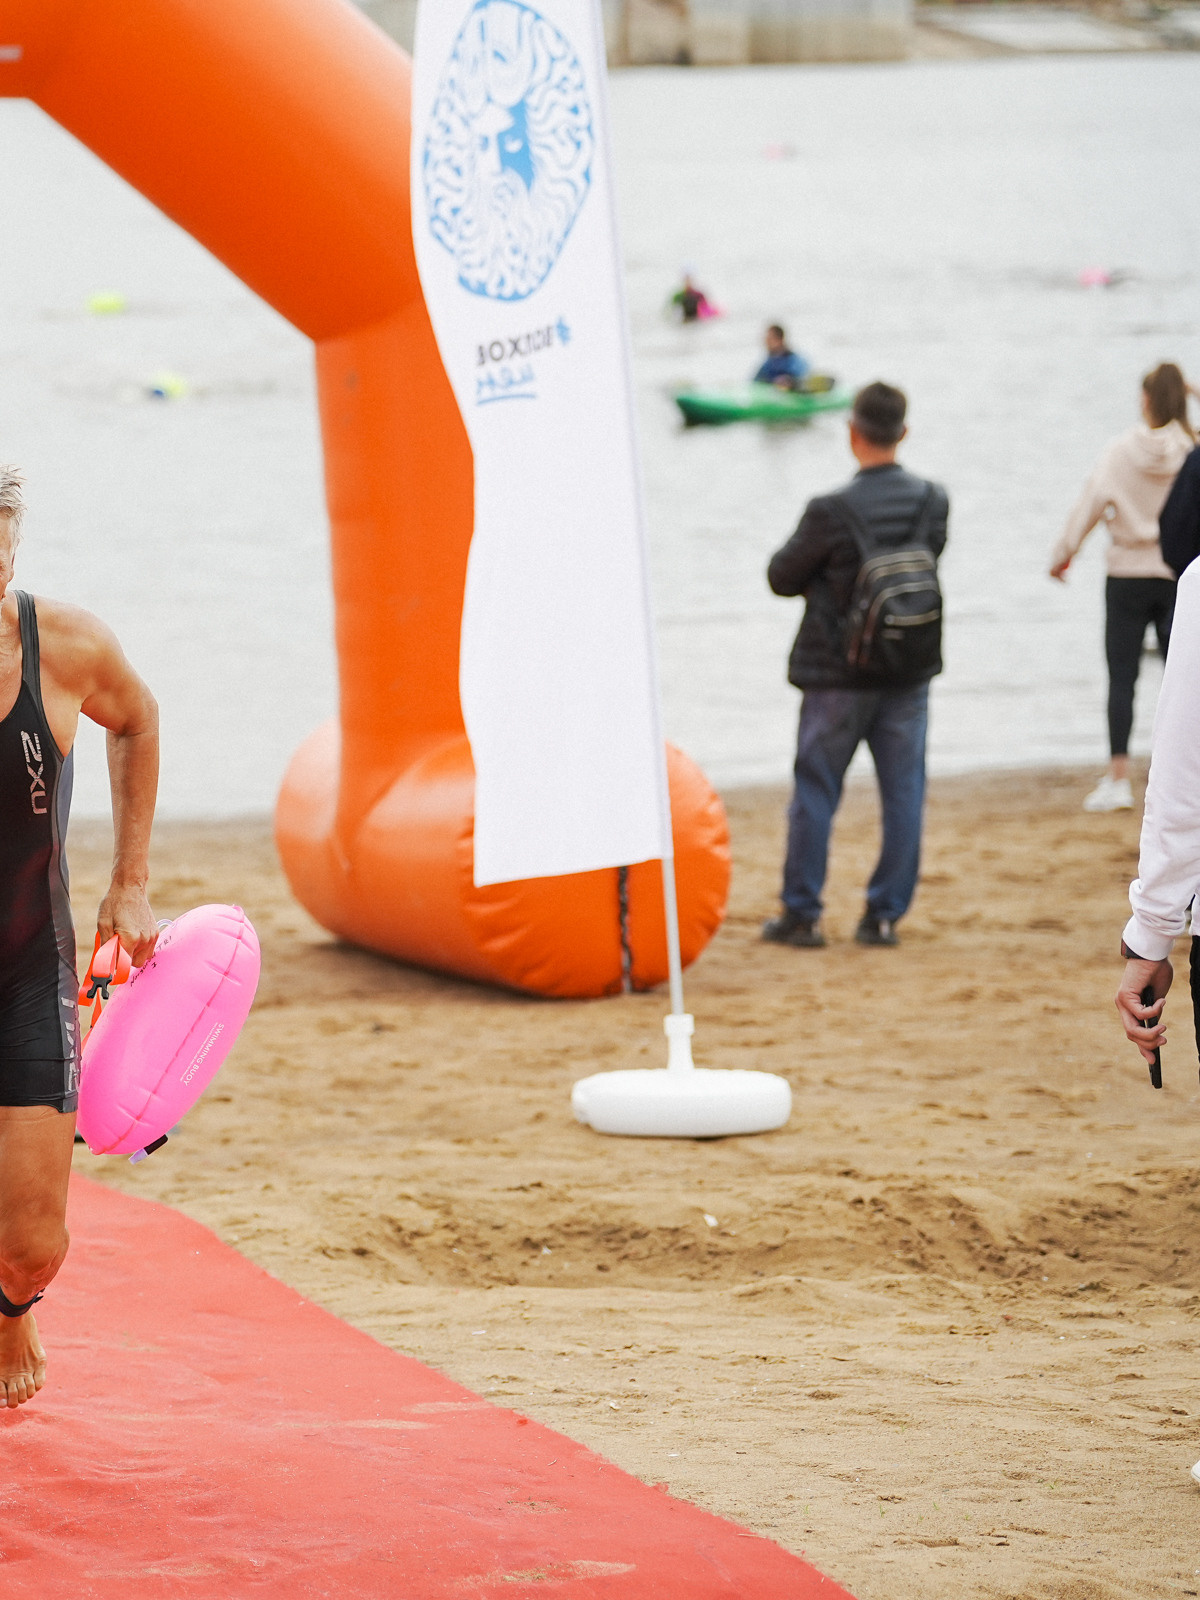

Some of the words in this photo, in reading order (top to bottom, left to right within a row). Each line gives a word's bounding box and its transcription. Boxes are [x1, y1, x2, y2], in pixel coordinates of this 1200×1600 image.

[21, 730, 47, 814] 2XU
[196, 1023, 225, 1064] SWIMMING
[183, 1064, 200, 1086] BUOY
